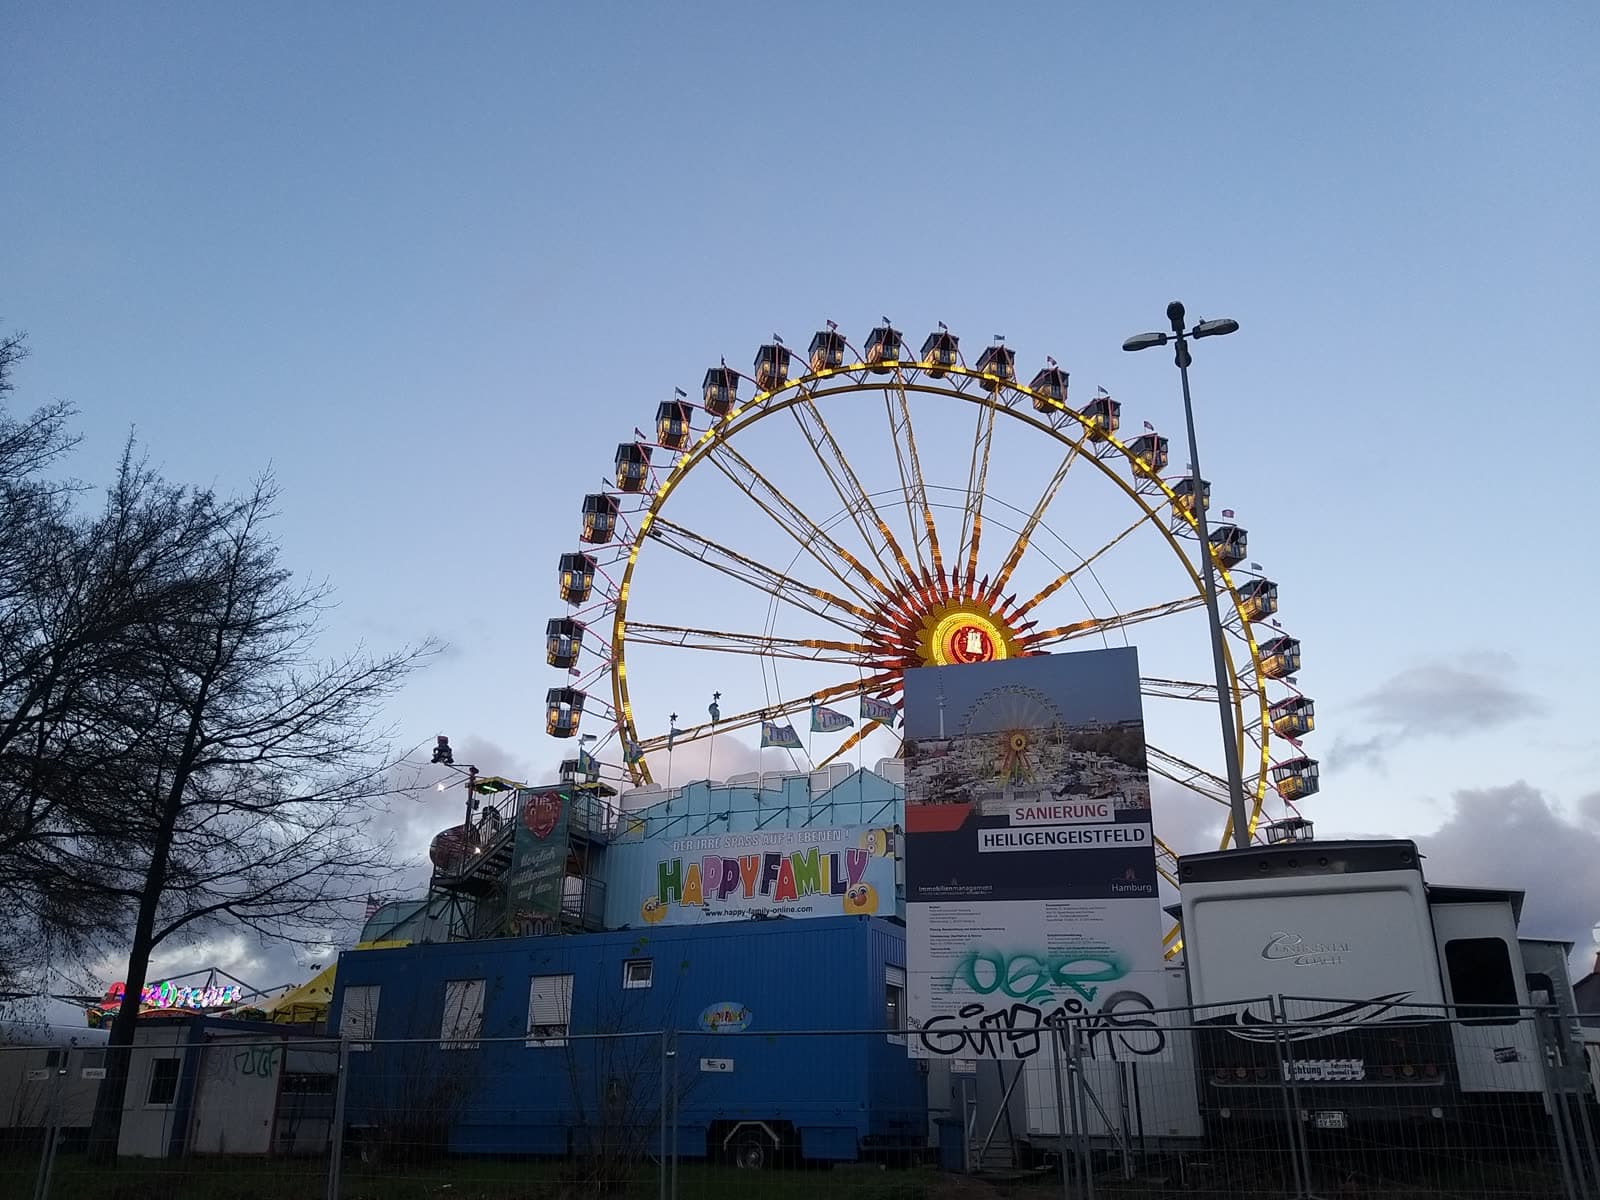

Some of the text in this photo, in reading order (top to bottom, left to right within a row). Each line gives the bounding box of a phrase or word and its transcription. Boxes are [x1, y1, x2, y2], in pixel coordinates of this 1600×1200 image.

[1015, 804, 1108, 821] SANIERUNG
[673, 839, 696, 852] DER
[696, 837, 720, 850] IRRE
[724, 834, 759, 849] SPASS
[763, 833, 786, 845] AUF
[798, 830, 841, 843] EBENEN
[983, 828, 1145, 847] HEILIGENGEISTFELD
[1111, 882, 1153, 893] Hamburg
[704, 905, 813, 917] www.happy-family-online.com
